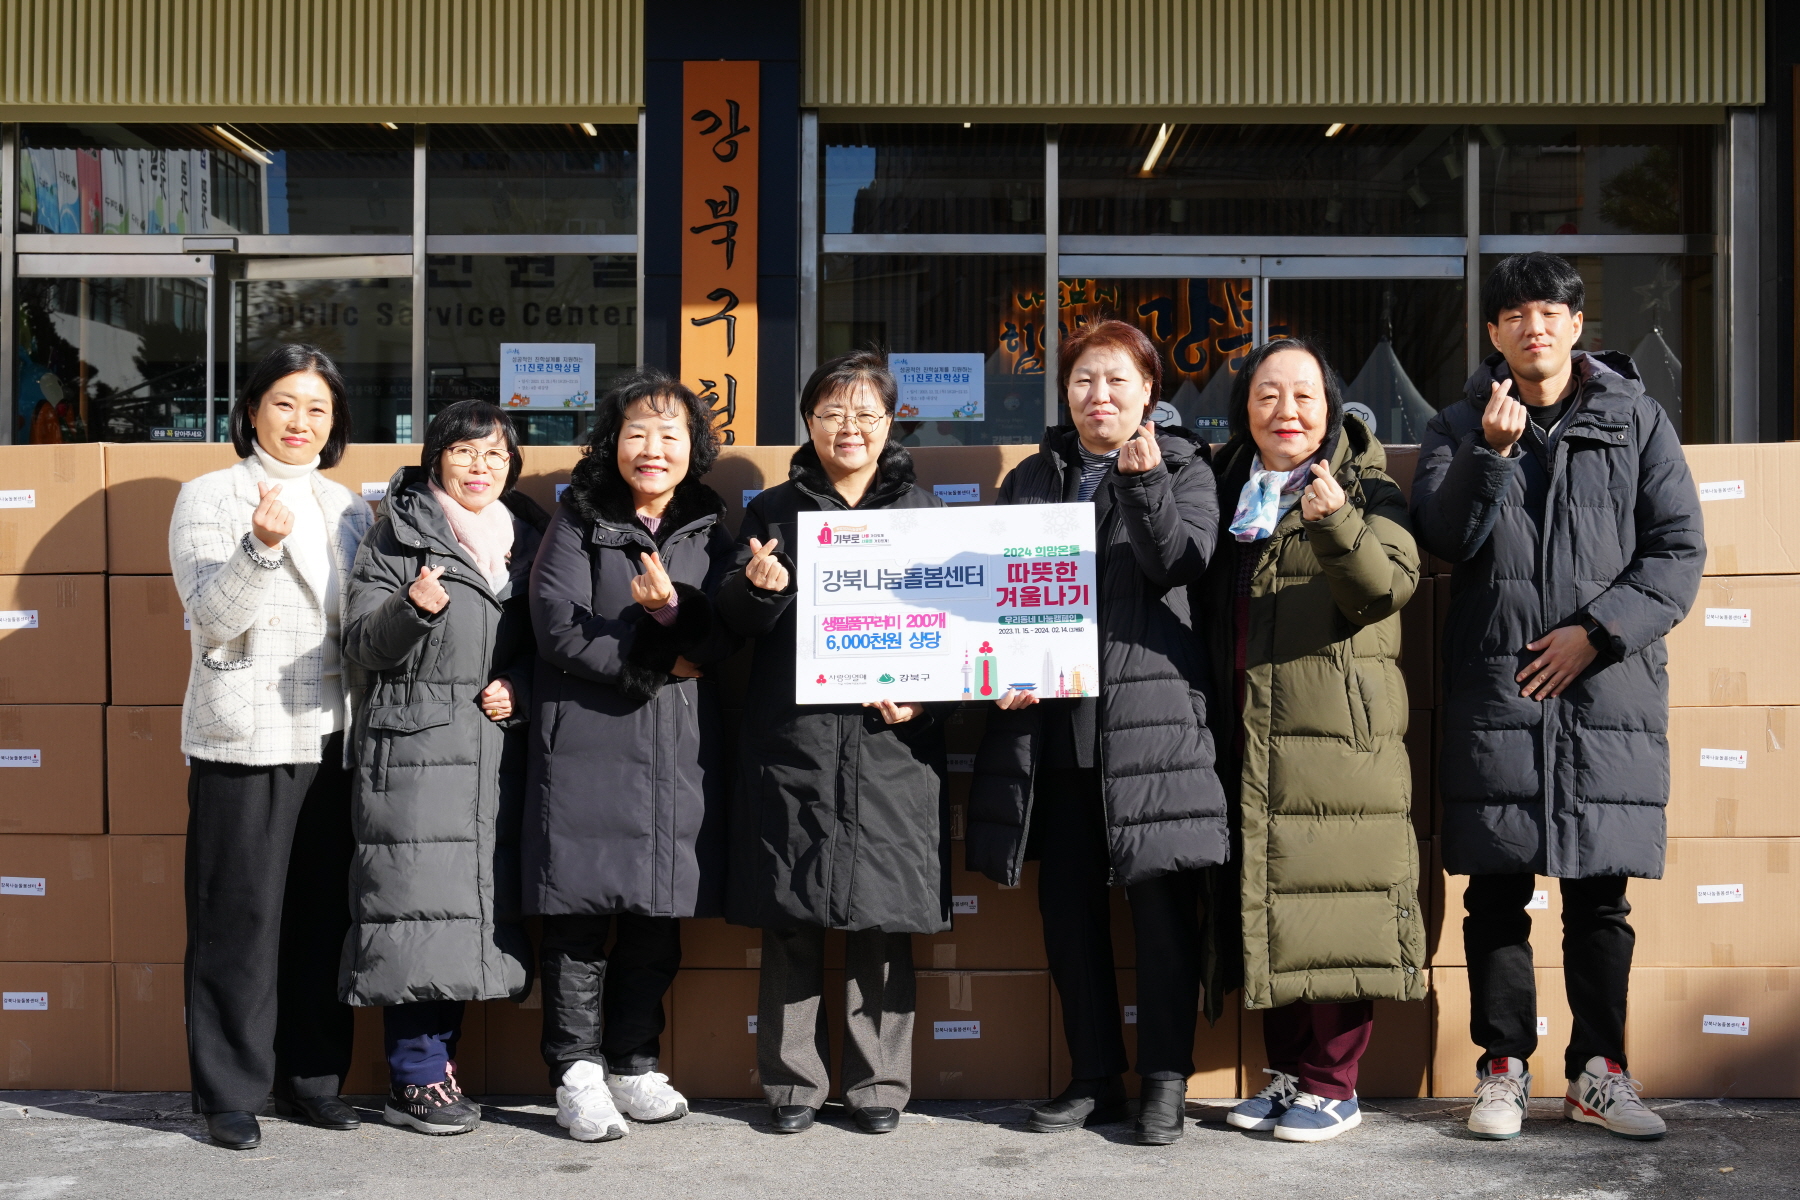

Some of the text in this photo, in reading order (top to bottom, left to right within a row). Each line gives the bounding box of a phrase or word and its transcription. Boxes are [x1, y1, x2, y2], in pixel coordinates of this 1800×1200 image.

[377, 302, 507, 326] Sevice
[523, 303, 637, 326] Center
[515, 363, 581, 373] 1:1진로진학상담
[903, 373, 970, 383] 1:1진로진학상담
[166, 429, 173, 437] 꼭
[174, 430, 202, 438] 닫아주세요
[833, 533, 860, 544] 기부로
[1003, 544, 1081, 558] 2024 희망온돌
[822, 564, 984, 592] 강북나눔돌봄센터
[1007, 561, 1078, 583] 따뜻한
[996, 584, 1089, 608] 겨울나기
[821, 611, 946, 632] 생필품꾸러미 200개
[1004, 614, 1077, 625] 우리동네 나눔캠페인
[826, 630, 942, 652] 6,000천원 상당
[899, 673, 930, 683] 강북구
